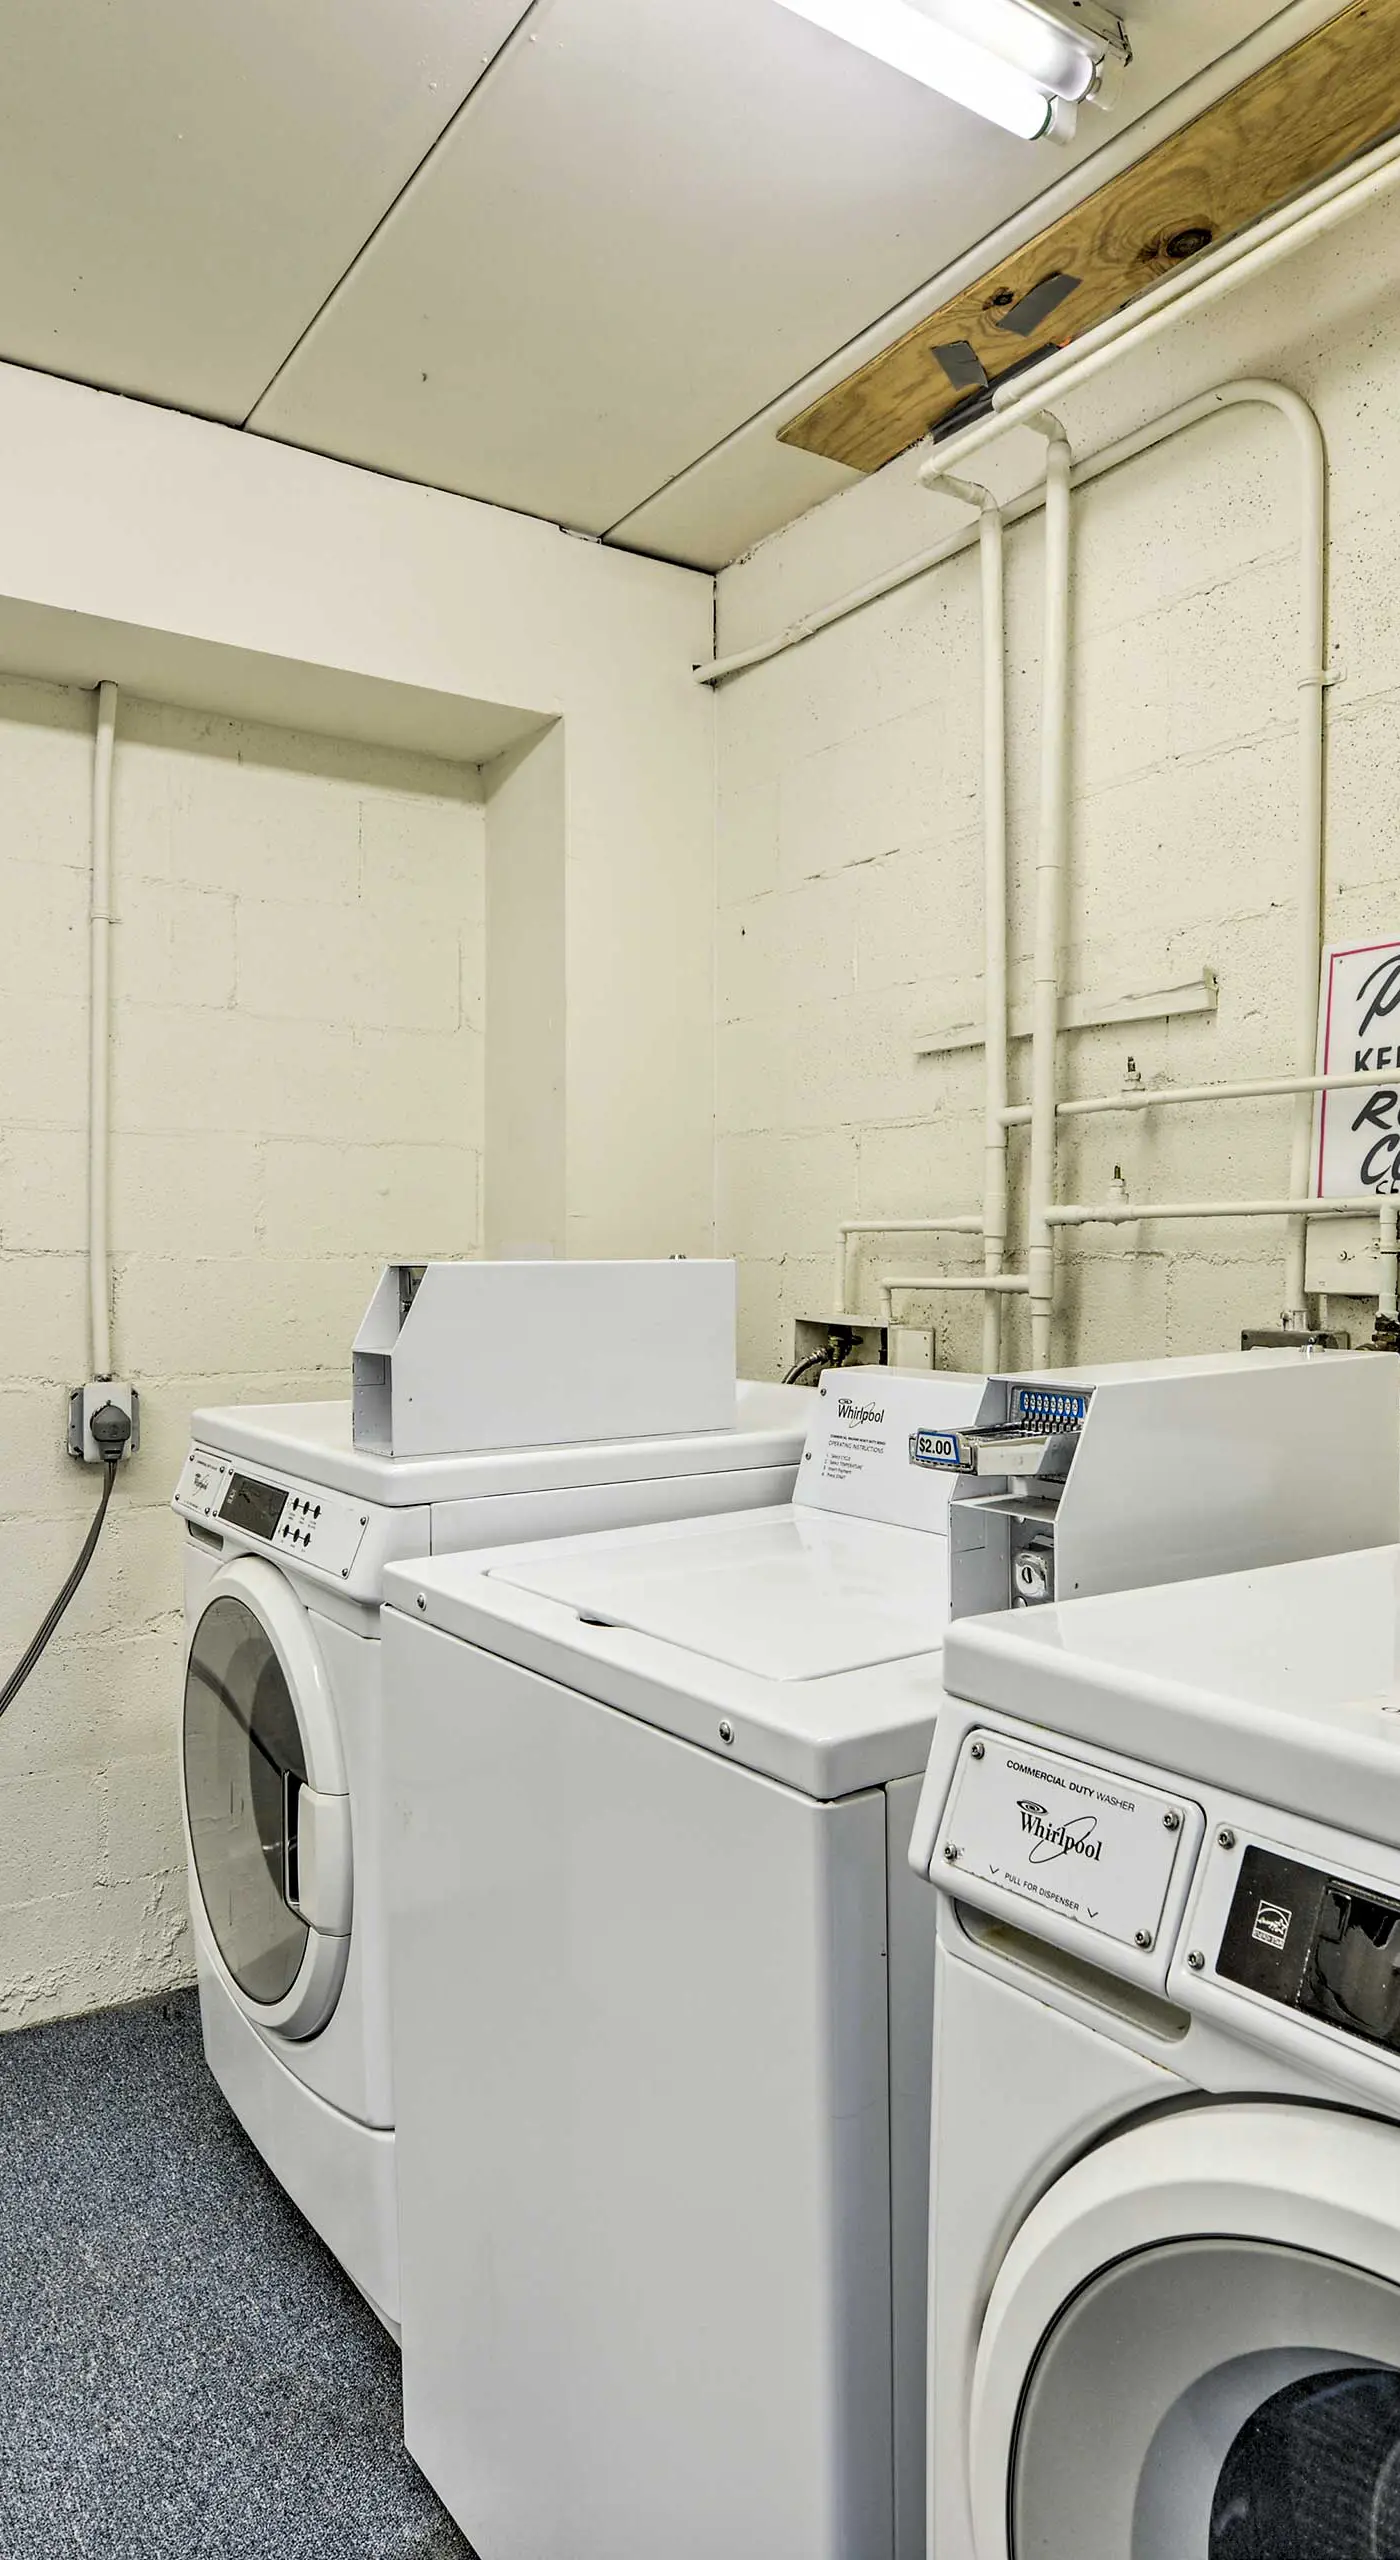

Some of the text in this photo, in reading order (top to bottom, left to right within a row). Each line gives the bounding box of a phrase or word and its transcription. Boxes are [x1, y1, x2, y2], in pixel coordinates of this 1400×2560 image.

[1351, 1090, 1400, 1132] R
[837, 1404, 885, 1425] Whirlpool
[919, 1437, 952, 1456] $2.00
[1006, 1760, 1136, 1813] COMMERCIAL DUTY WASHER
[1020, 1811, 1102, 1861] Whirlpool
[1004, 1872, 1080, 1911] PULL FOR DISPENSER
